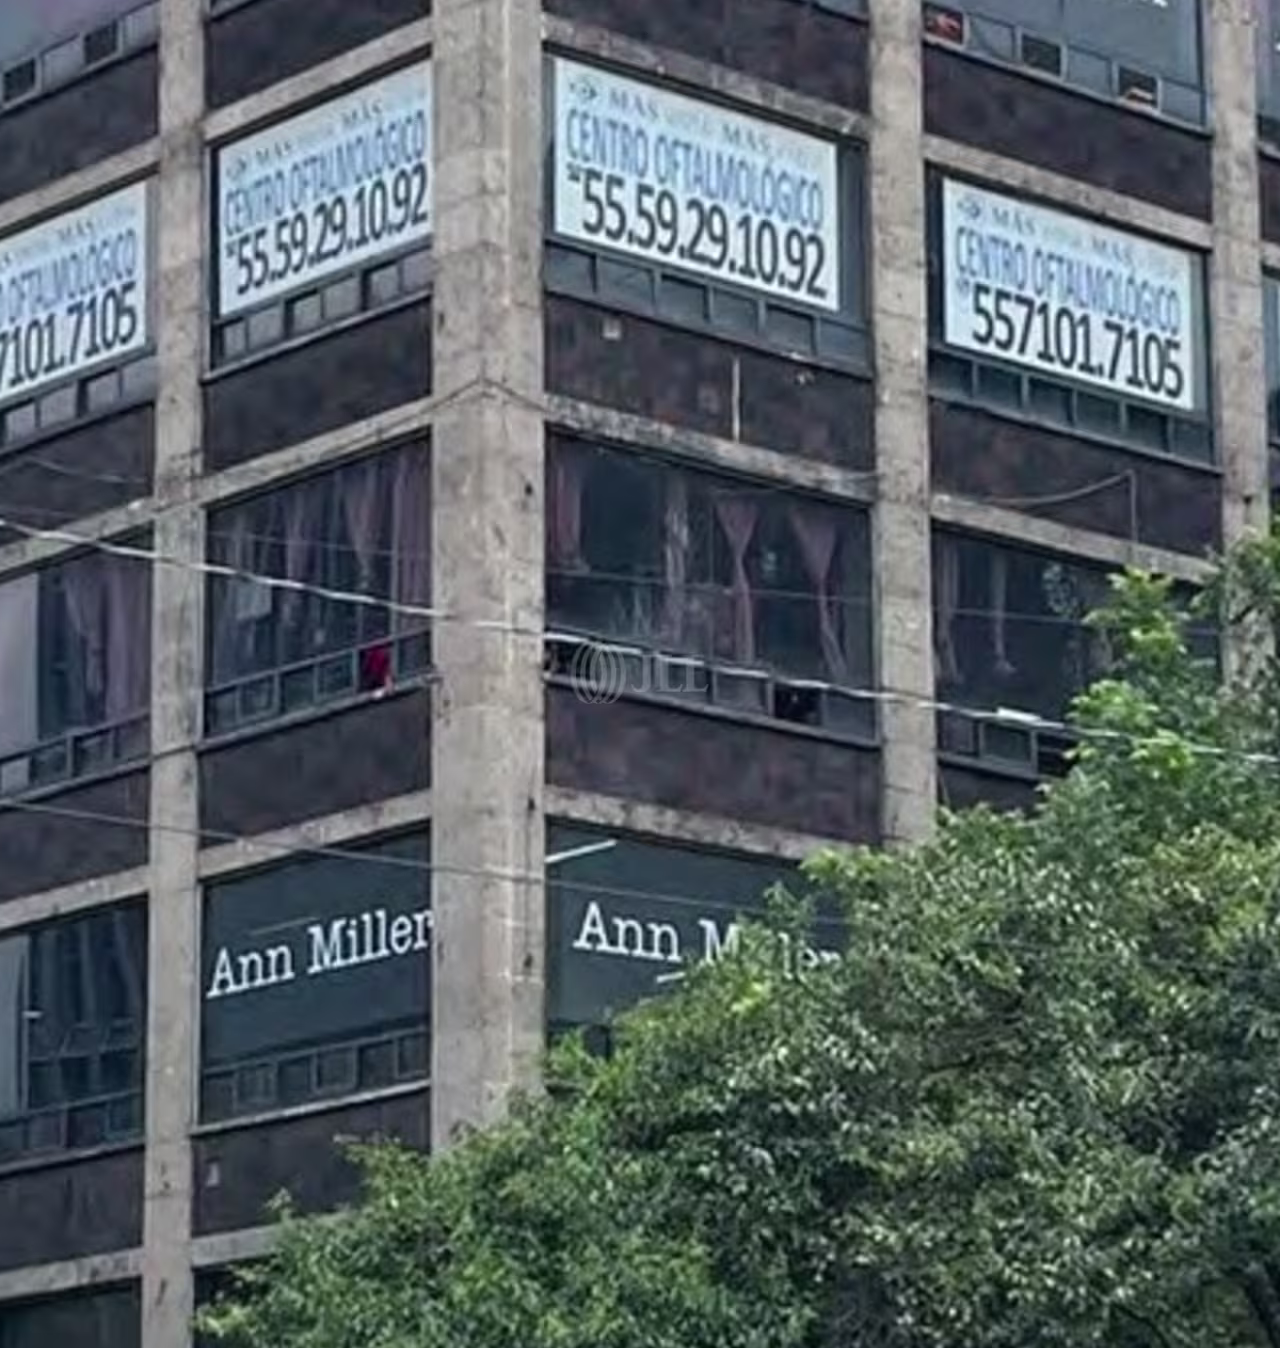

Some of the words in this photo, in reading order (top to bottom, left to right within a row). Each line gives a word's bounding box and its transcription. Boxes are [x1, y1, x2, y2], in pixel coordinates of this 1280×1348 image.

[567, 109, 649, 179] CENTRO
[226, 170, 285, 236] CENTRO
[582, 167, 827, 298] 55.59.29.10.92
[956, 226, 1027, 291] CENTRO
[206, 943, 296, 999] Ann
[307, 908, 435, 974] Miller
[573, 901, 683, 964] Ann
